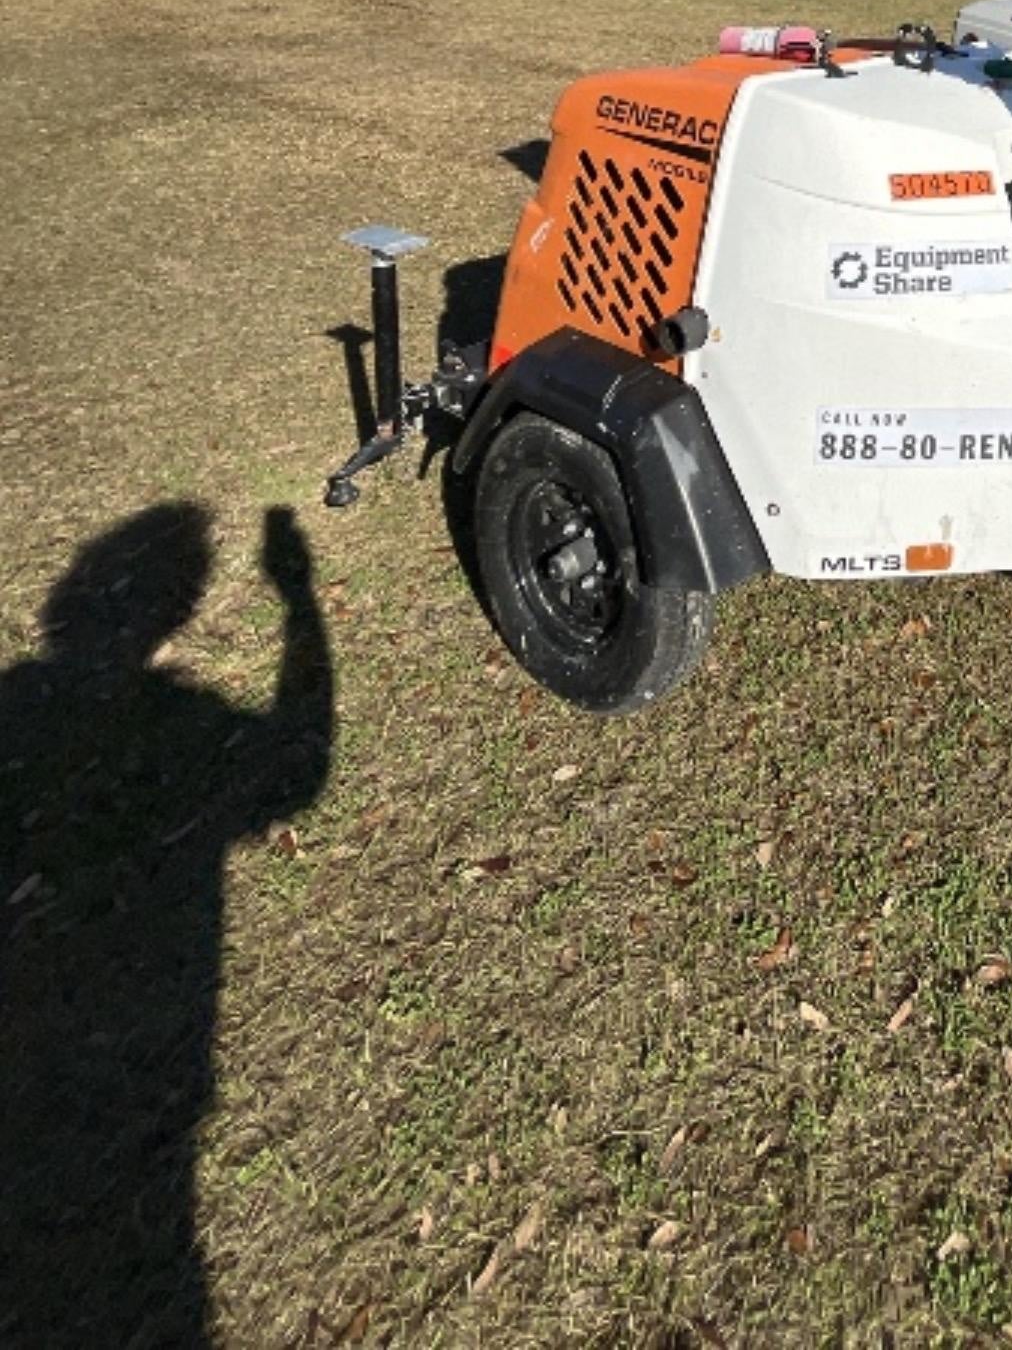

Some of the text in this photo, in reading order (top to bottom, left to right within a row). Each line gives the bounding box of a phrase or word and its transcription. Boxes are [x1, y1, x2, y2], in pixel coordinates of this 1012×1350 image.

[596, 95, 718, 144] GENERAC
[874, 246, 1009, 273] Equipment
[874, 272, 952, 295] Share
[822, 411, 906, 426] CALL NOW
